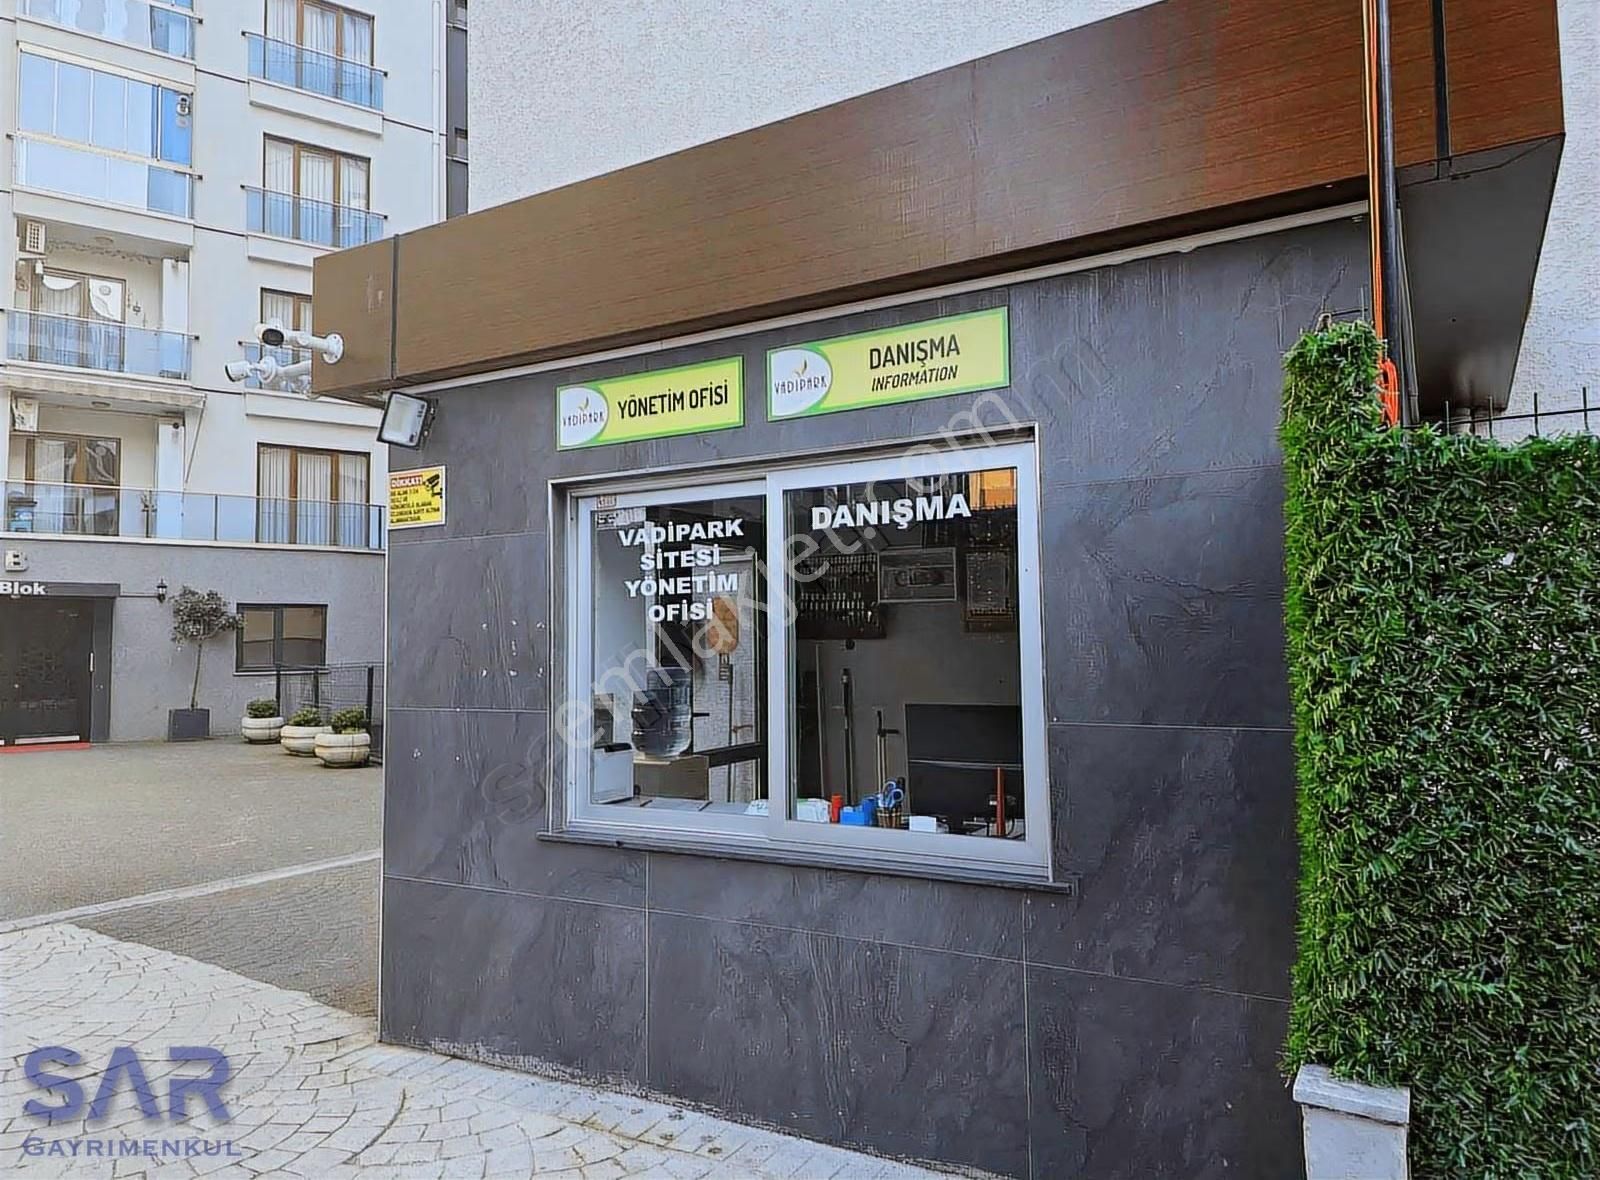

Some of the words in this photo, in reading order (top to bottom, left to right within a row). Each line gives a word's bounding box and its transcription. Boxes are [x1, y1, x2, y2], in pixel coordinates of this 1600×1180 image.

[869, 334, 960, 369] DANIŞMA
[871, 365, 958, 391] INFORMATION
[618, 388, 684, 419] YÖNETİM
[689, 379, 728, 408] OFİSİ
[811, 493, 972, 530] DANIŞMA
[618, 518, 744, 547] VADİPARK
[640, 543, 720, 571] SİTESİ
[0, 581, 47, 595] Blok
[624, 570, 738, 598] YÖNETİM
[649, 598, 713, 622] OFİSİ
